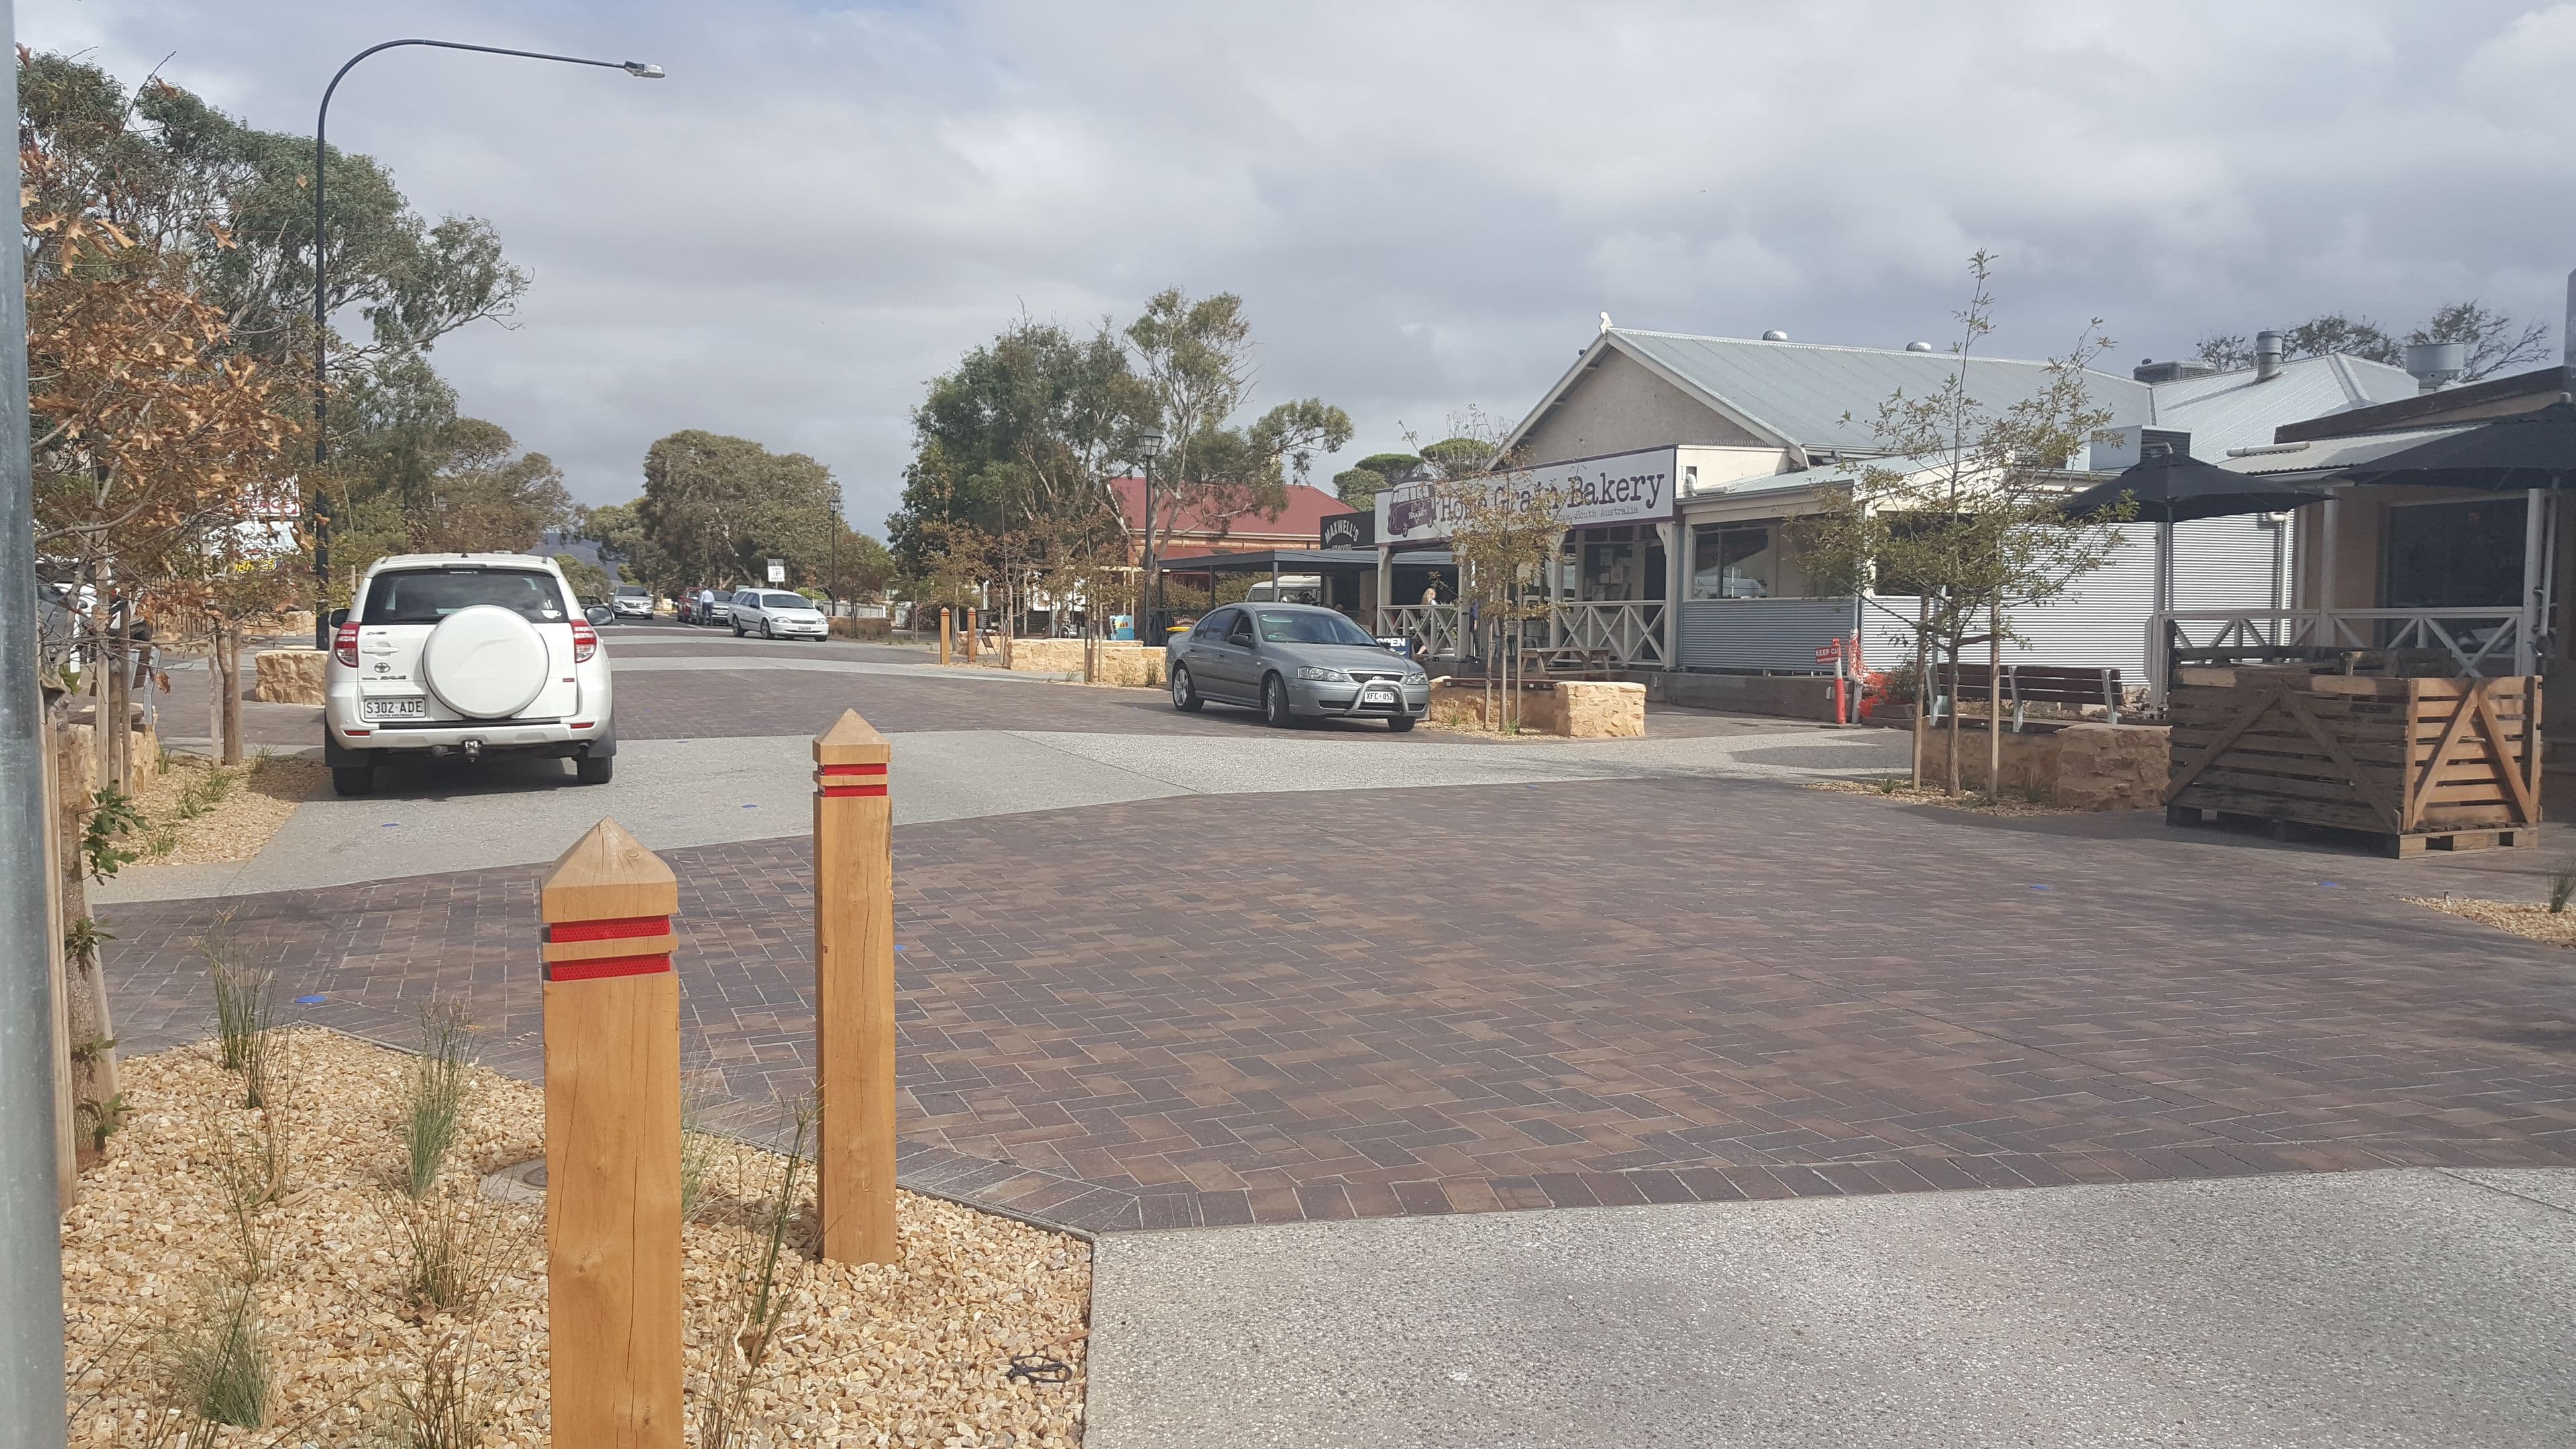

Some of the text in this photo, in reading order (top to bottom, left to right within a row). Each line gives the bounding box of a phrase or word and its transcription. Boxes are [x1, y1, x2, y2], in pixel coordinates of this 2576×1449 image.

[1568, 472, 1664, 508] Bakery
[1576, 509, 1597, 519] South
[1601, 506, 1638, 517] Australia
[1325, 519, 1358, 543] MAXWELL'S
[1376, 638, 1405, 647] OPEN
